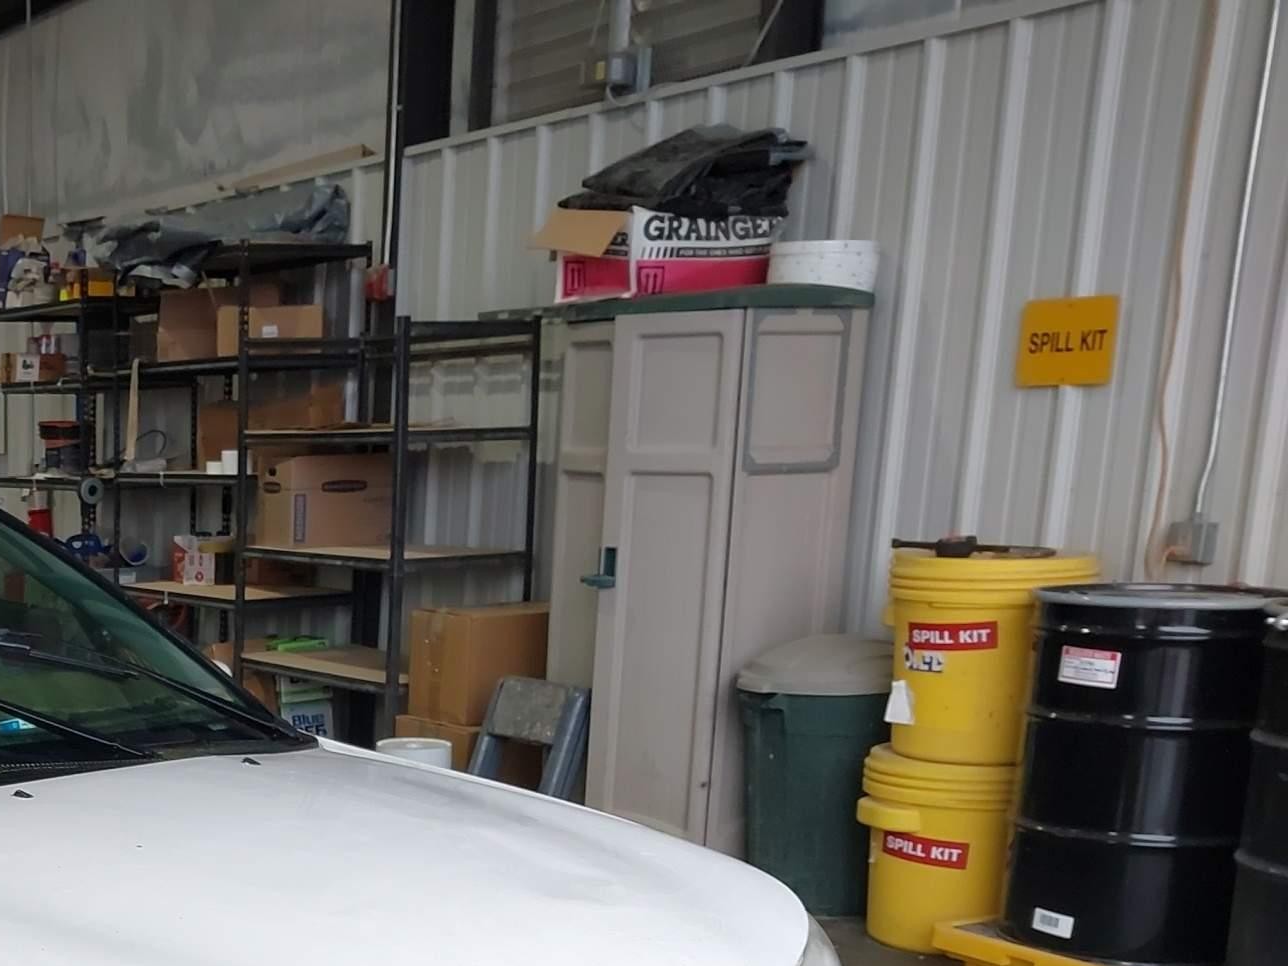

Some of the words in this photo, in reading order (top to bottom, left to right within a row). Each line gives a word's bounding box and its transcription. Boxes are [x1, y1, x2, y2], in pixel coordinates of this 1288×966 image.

[1028, 331, 1074, 354] SPILL
[1080, 329, 1108, 351] KIT
[912, 629, 954, 645] SPILL
[958, 628, 991, 644] KIT
[886, 835, 926, 858] SPILL
[930, 846, 963, 862] KIT
